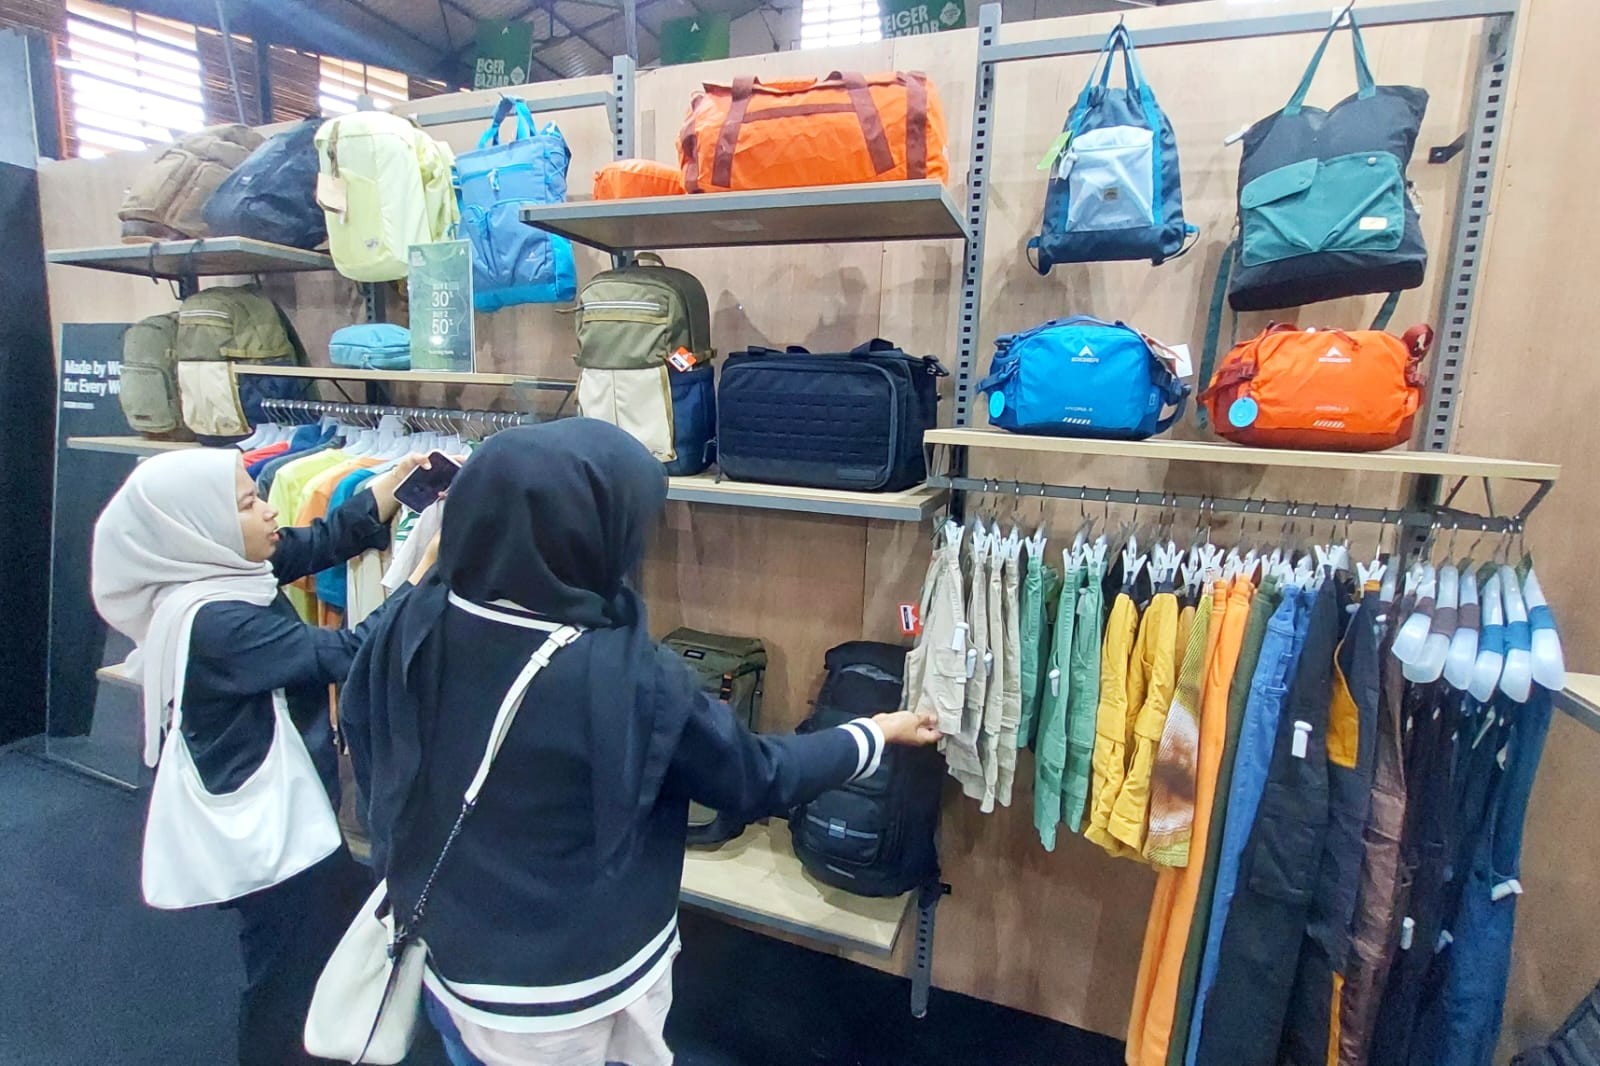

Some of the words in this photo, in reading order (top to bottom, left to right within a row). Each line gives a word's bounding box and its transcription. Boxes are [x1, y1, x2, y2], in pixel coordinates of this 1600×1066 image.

[882, 5, 929, 33] EIGER
[65, 359, 92, 375] Made
[93, 360, 107, 378] by
[64, 378, 79, 392] for
[79, 378, 107, 397] Every
